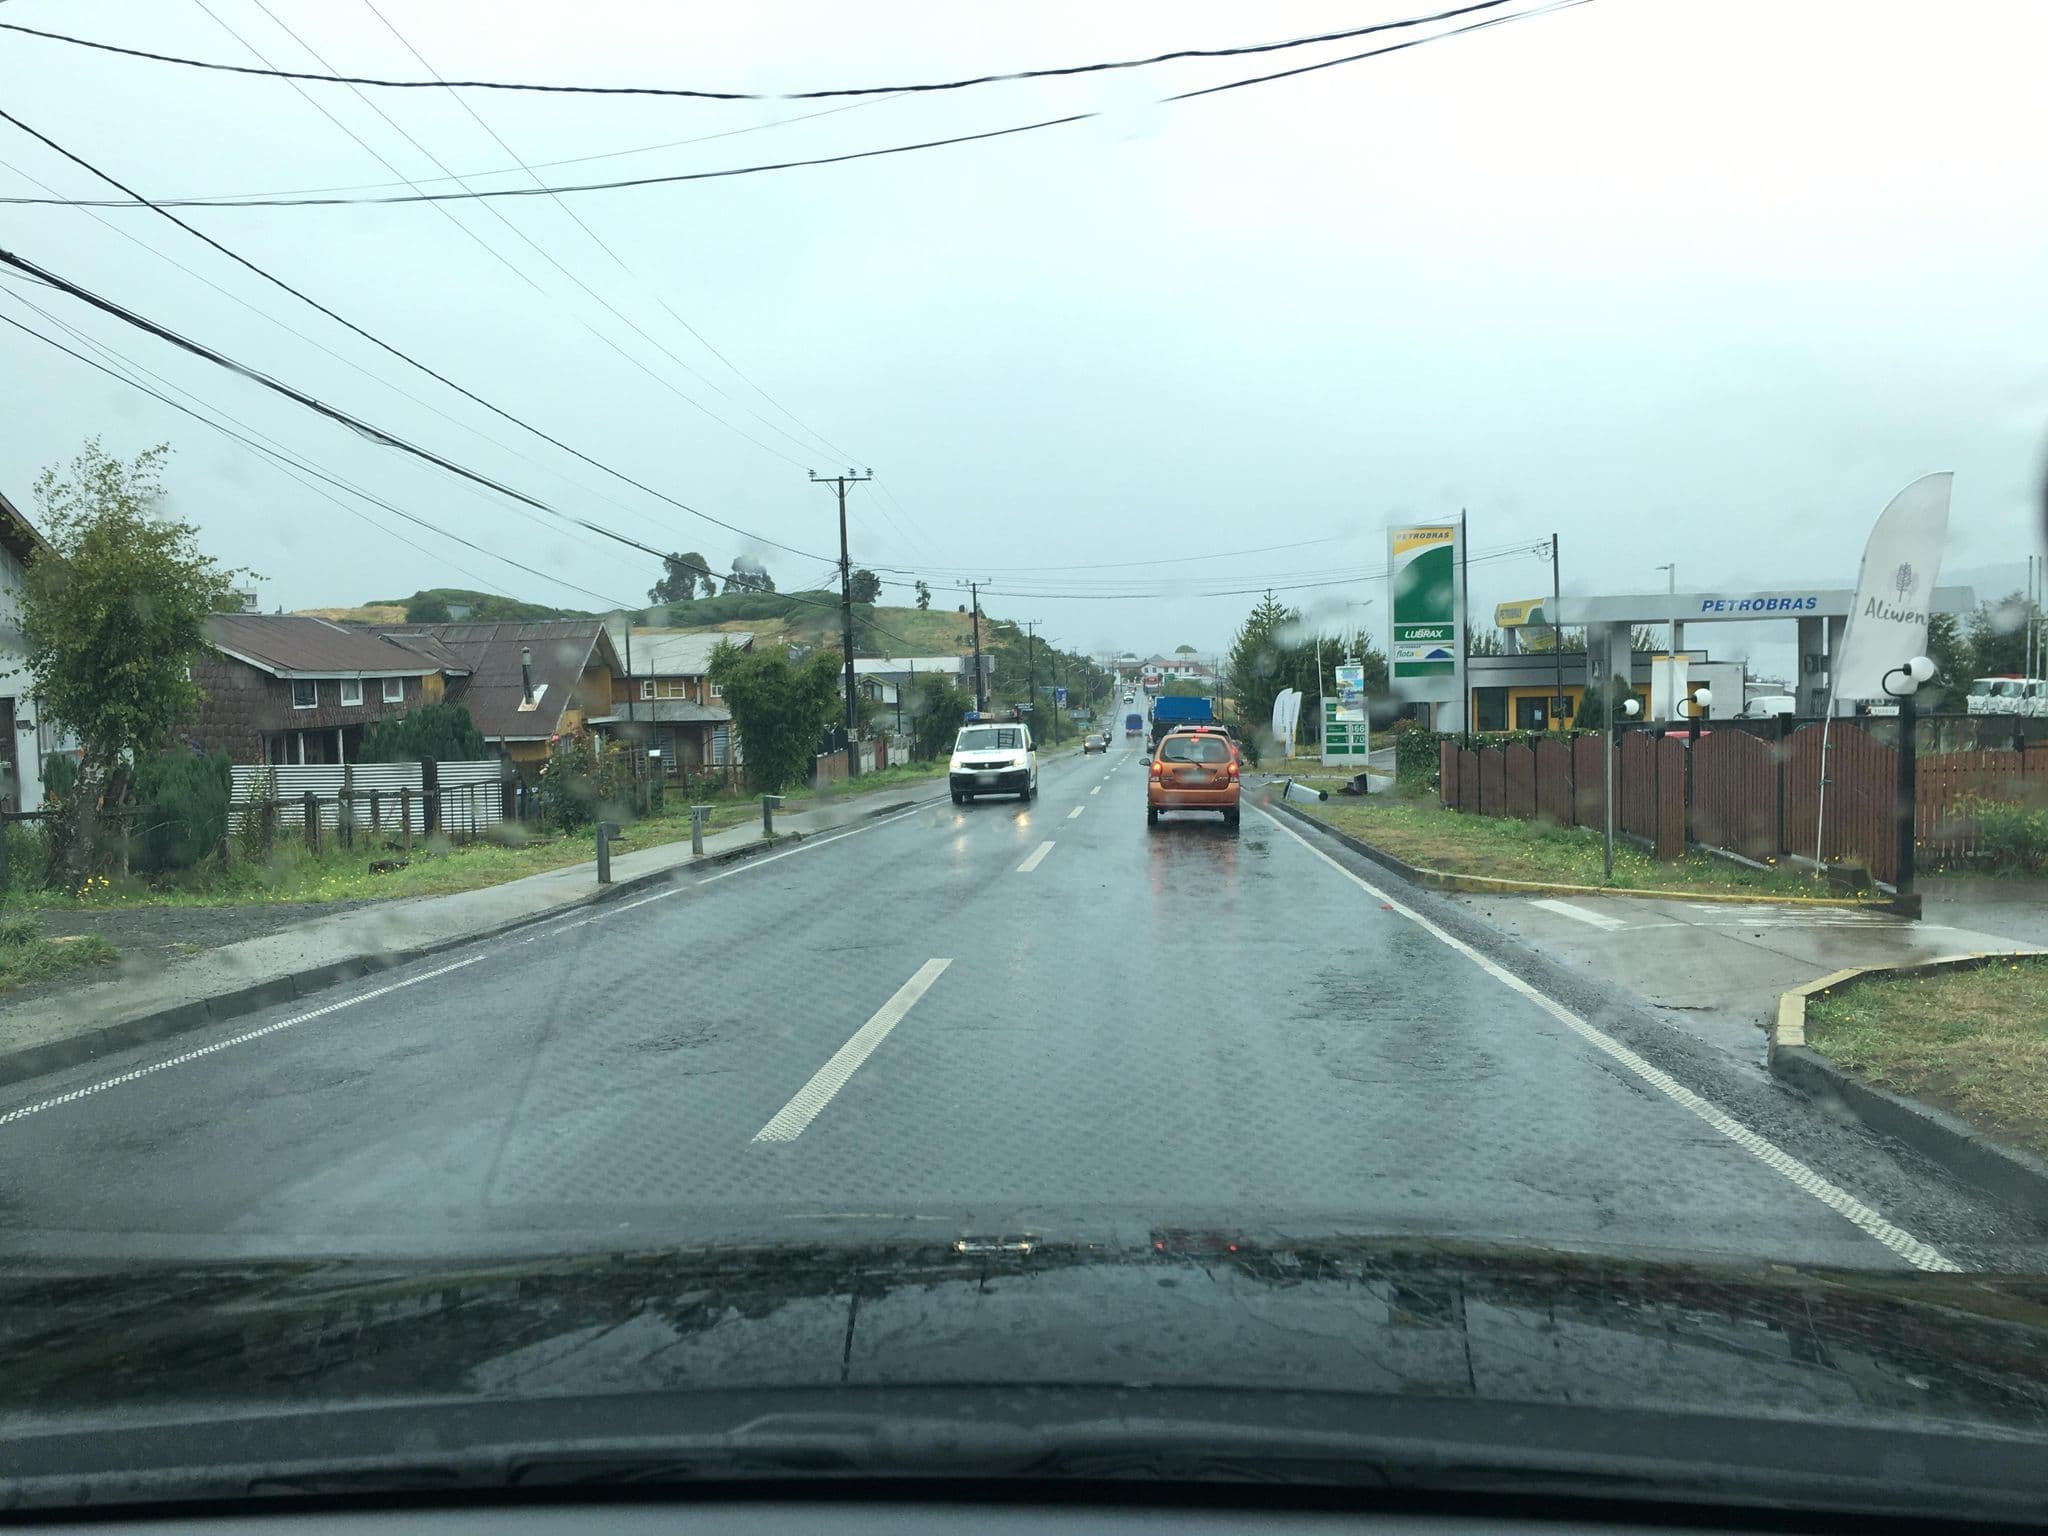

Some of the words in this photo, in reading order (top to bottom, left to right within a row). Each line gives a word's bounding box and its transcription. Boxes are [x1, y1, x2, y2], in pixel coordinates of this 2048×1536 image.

[1701, 597, 1817, 612] PETROBRAS
[1864, 596, 1928, 626] Aliwen
[1404, 629, 1443, 639] LUBRAX
